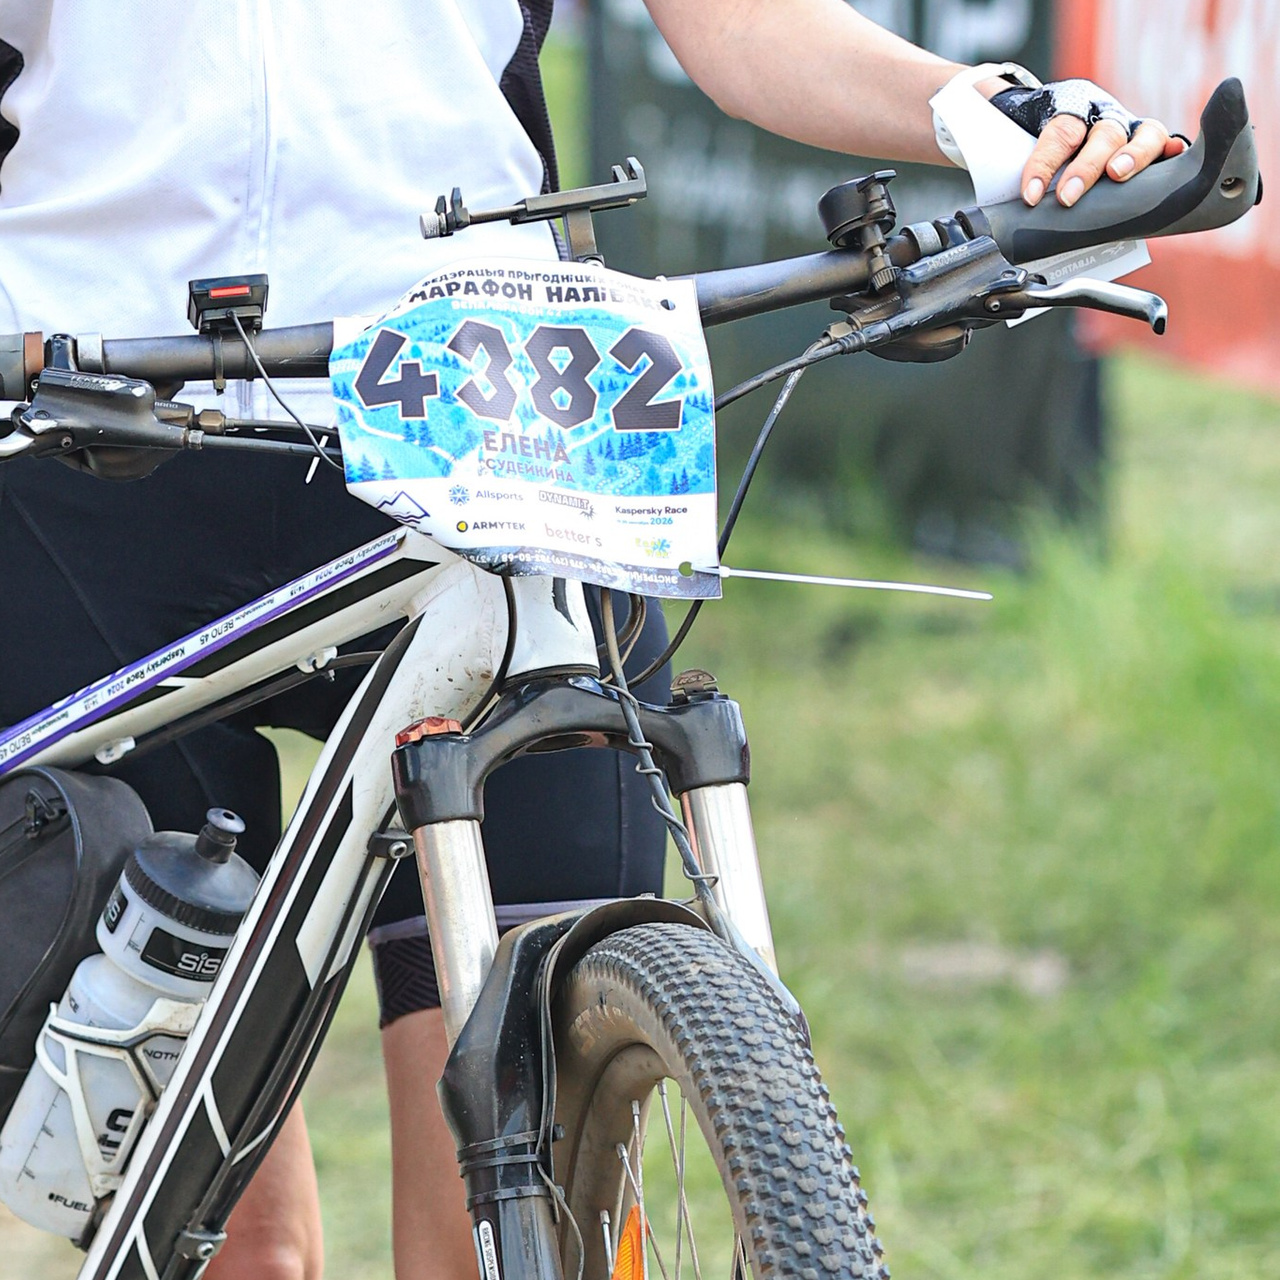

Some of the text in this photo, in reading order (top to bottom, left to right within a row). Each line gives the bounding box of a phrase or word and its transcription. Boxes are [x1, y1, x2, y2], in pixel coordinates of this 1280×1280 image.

[409, 279, 533, 304] МАРАФОН
[353, 319, 683, 431] 4382
[483, 429, 572, 465] ЕЛЕНА
[485, 458, 576, 484] СУДЕЙКИНА
[476, 490, 524, 502] Allsports
[615, 505, 688, 516] Kaspersky Race
[472, 521, 526, 531] ARMYTEK
[649, 517, 674, 526] 2026
[211, 619, 234, 638] ВЕЛО
[107, 645, 186, 697] Kaspersky Race 2024
[8, 733, 31, 754] ВЕЛО
